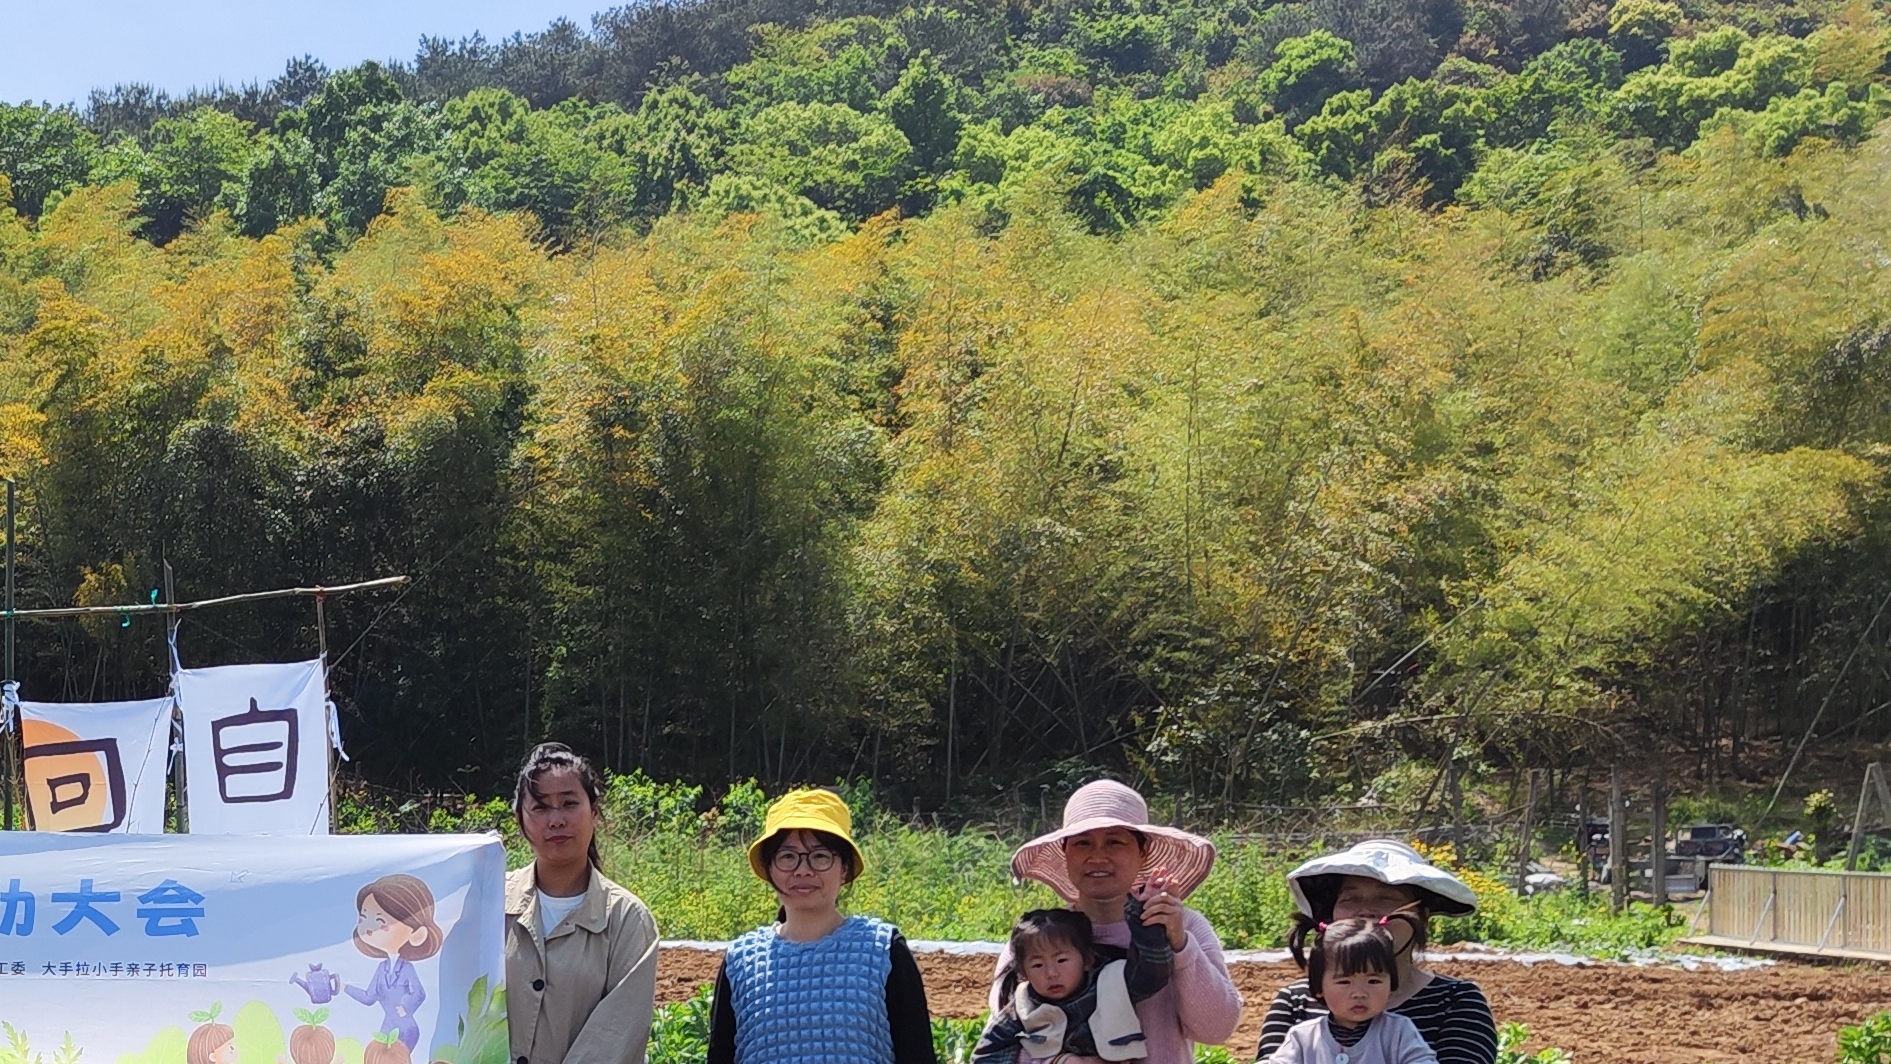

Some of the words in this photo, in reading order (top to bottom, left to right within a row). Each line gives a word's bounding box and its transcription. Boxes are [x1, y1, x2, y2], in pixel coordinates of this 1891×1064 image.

[24, 737, 126, 832] 回
[211, 697, 299, 803] 自
[41, 960, 208, 979] 大手拉小手亲子托育园
